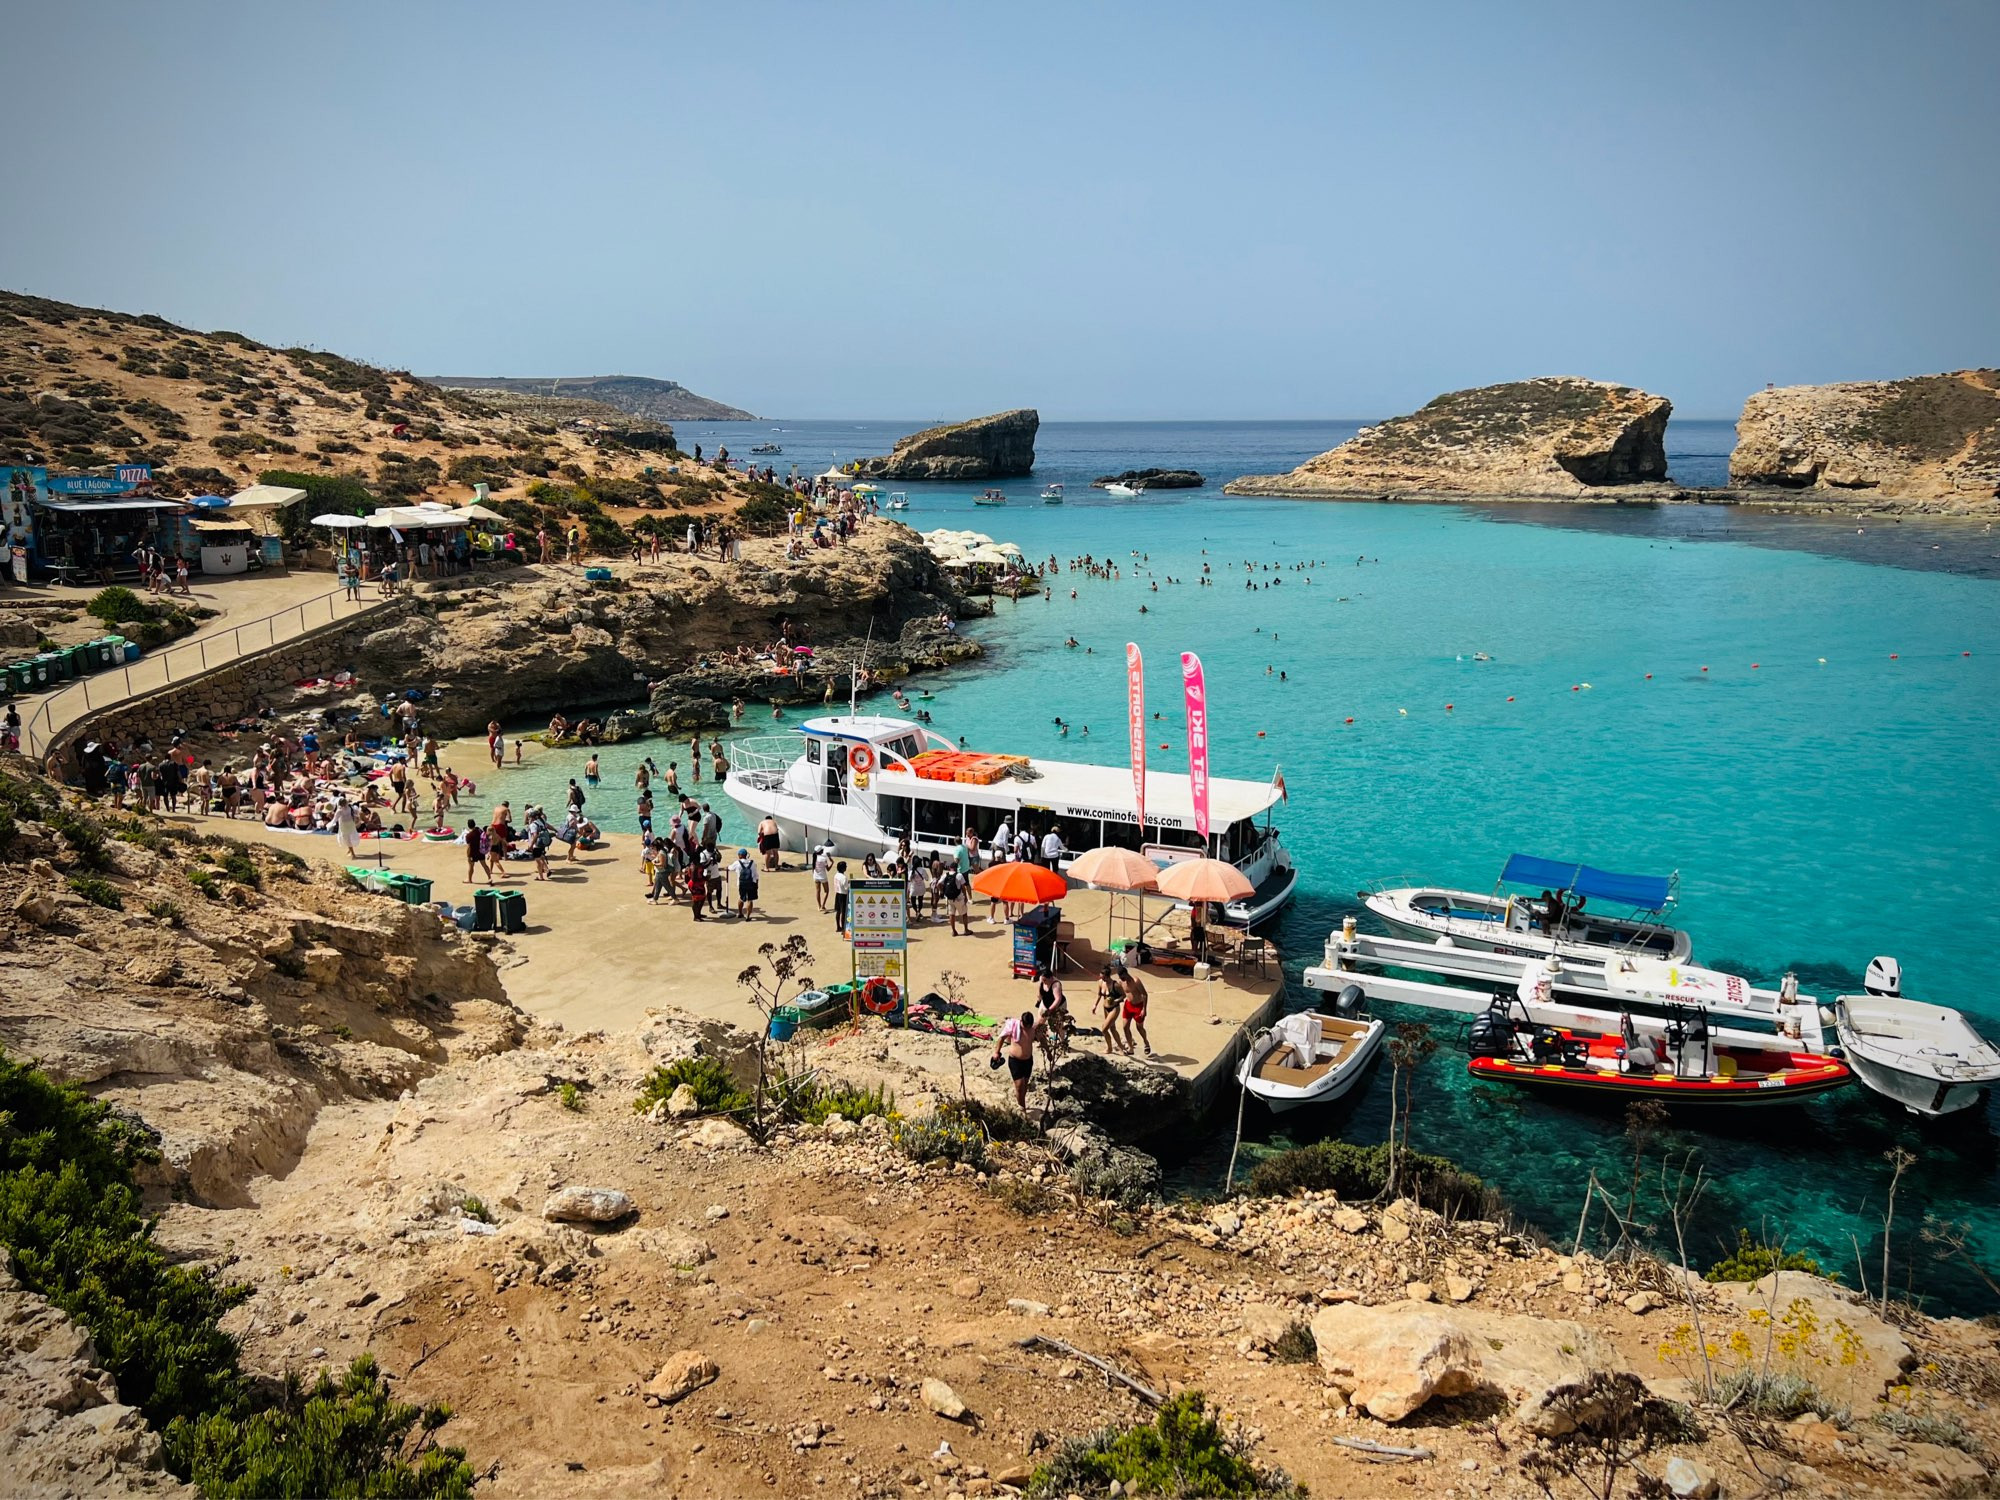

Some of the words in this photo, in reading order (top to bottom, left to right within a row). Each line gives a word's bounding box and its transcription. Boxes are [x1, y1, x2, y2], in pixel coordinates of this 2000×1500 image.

[119, 468, 148, 483] PIZZA
[67, 481, 82, 489] BLUE
[84, 481, 111, 489] LAGOON
[1067, 806, 1182, 827] www.cominoferies.com
[1480, 934, 1509, 945] LAGOON
[1868, 968, 1884, 980] HONDA
[1726, 976, 1744, 1004] RESCUE
[1665, 994, 1696, 1003] RESCUE
